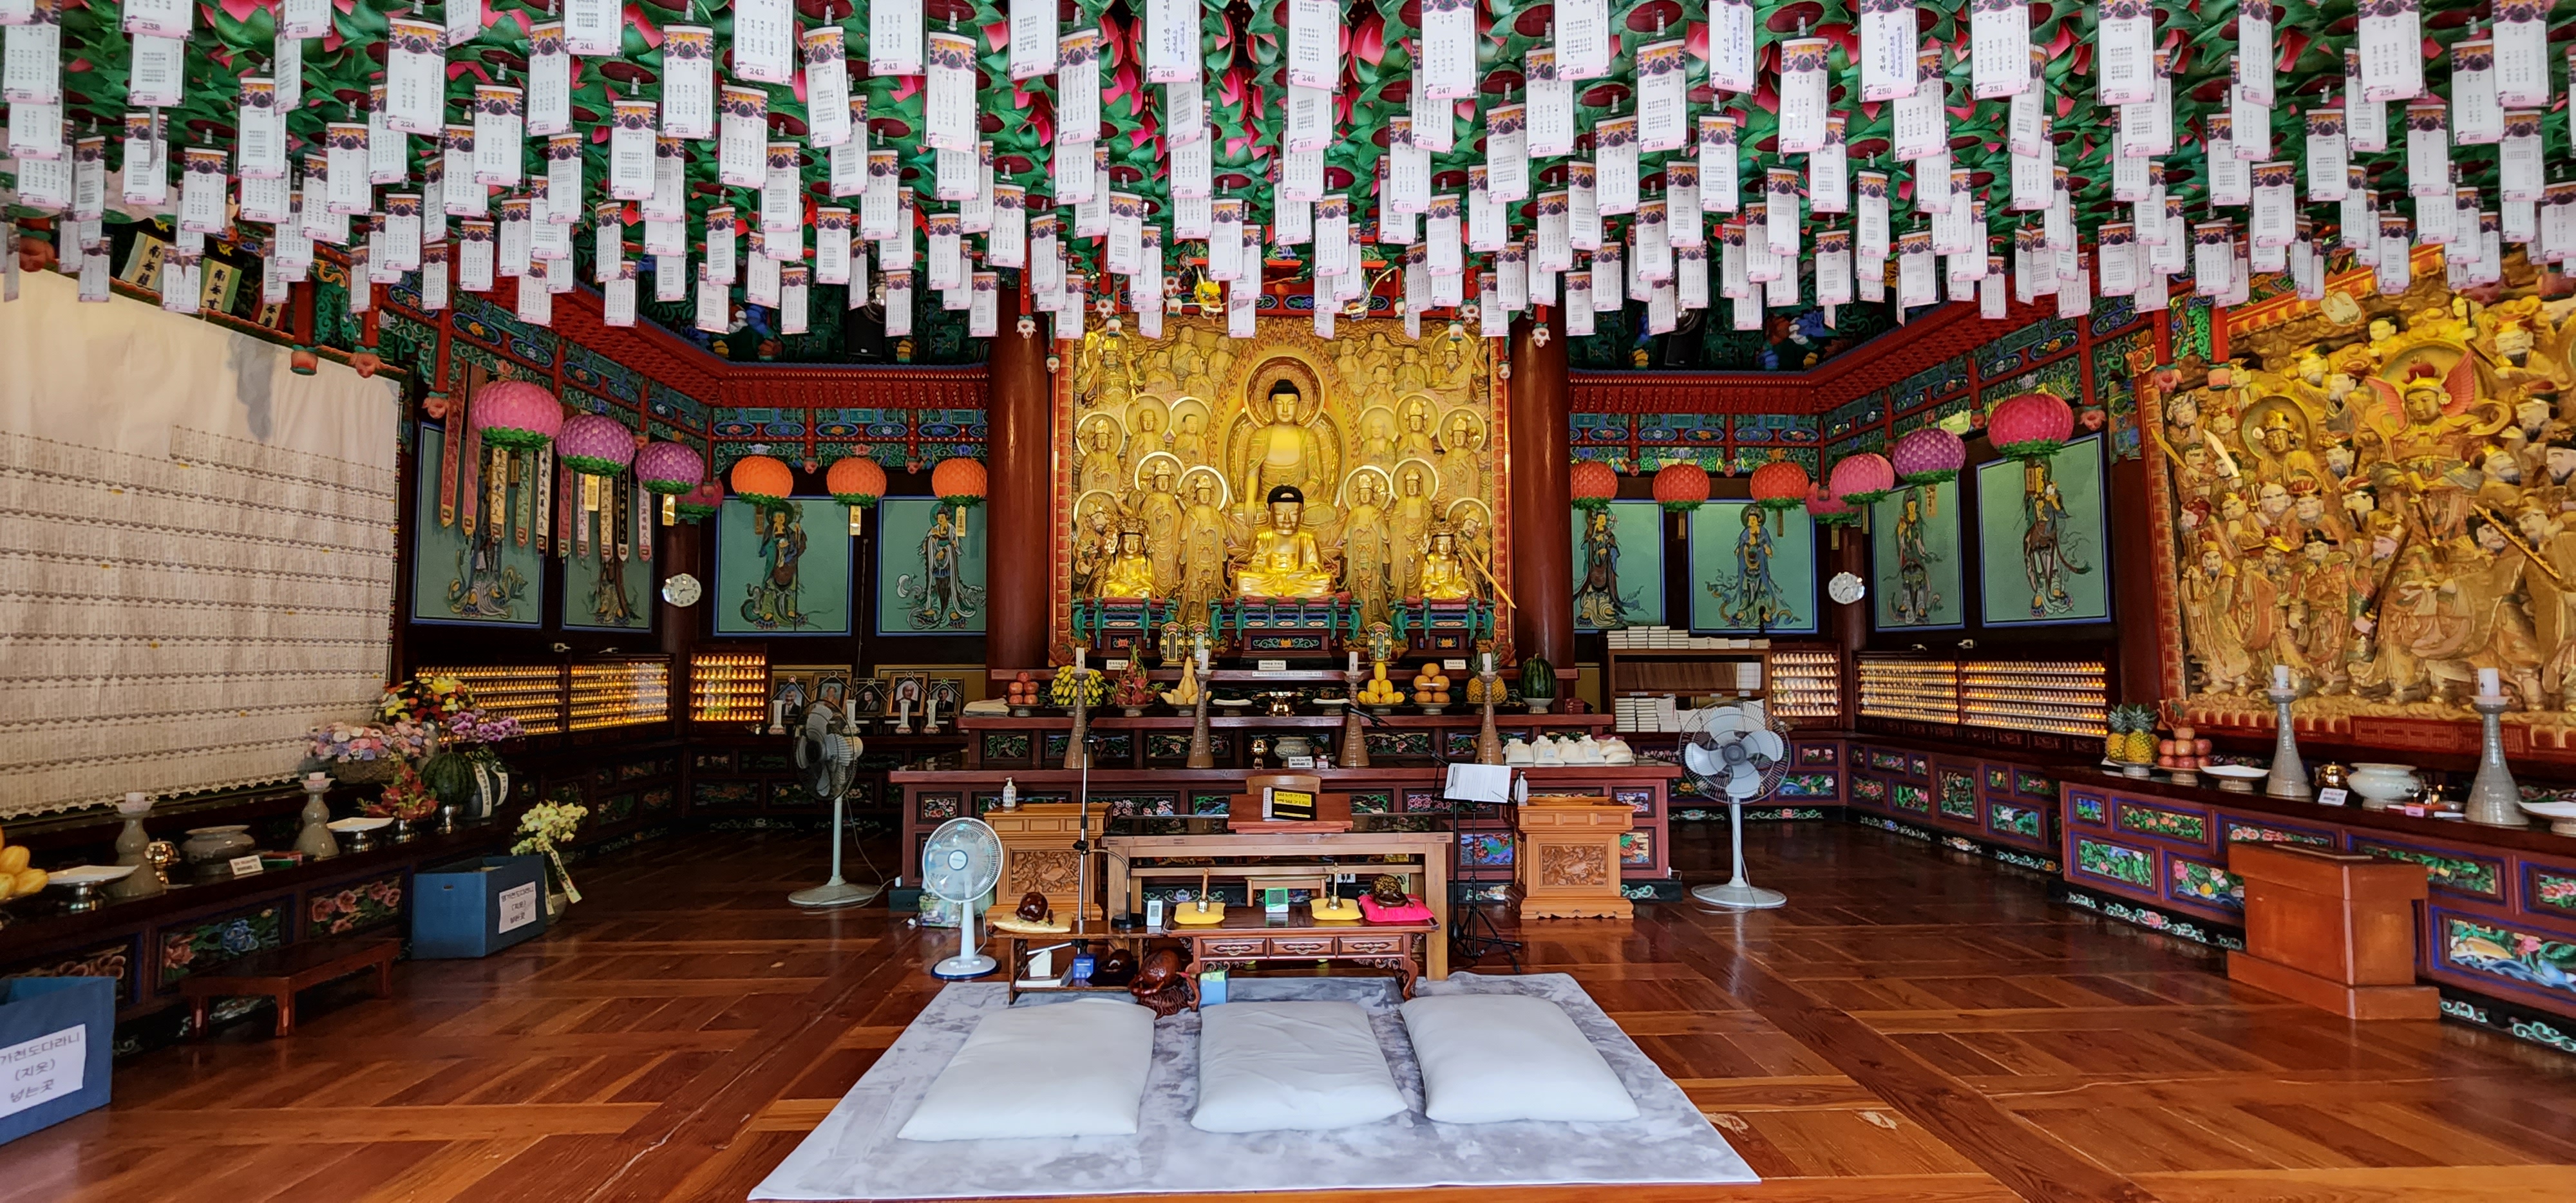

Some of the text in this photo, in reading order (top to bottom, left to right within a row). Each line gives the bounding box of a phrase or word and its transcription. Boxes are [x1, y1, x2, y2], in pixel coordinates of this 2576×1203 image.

[142, 22, 160, 31] 238
[750, 68, 765, 76] 242
[1302, 75, 1316, 83] 246
[15, 1059, 55, 1081] (지옷)
